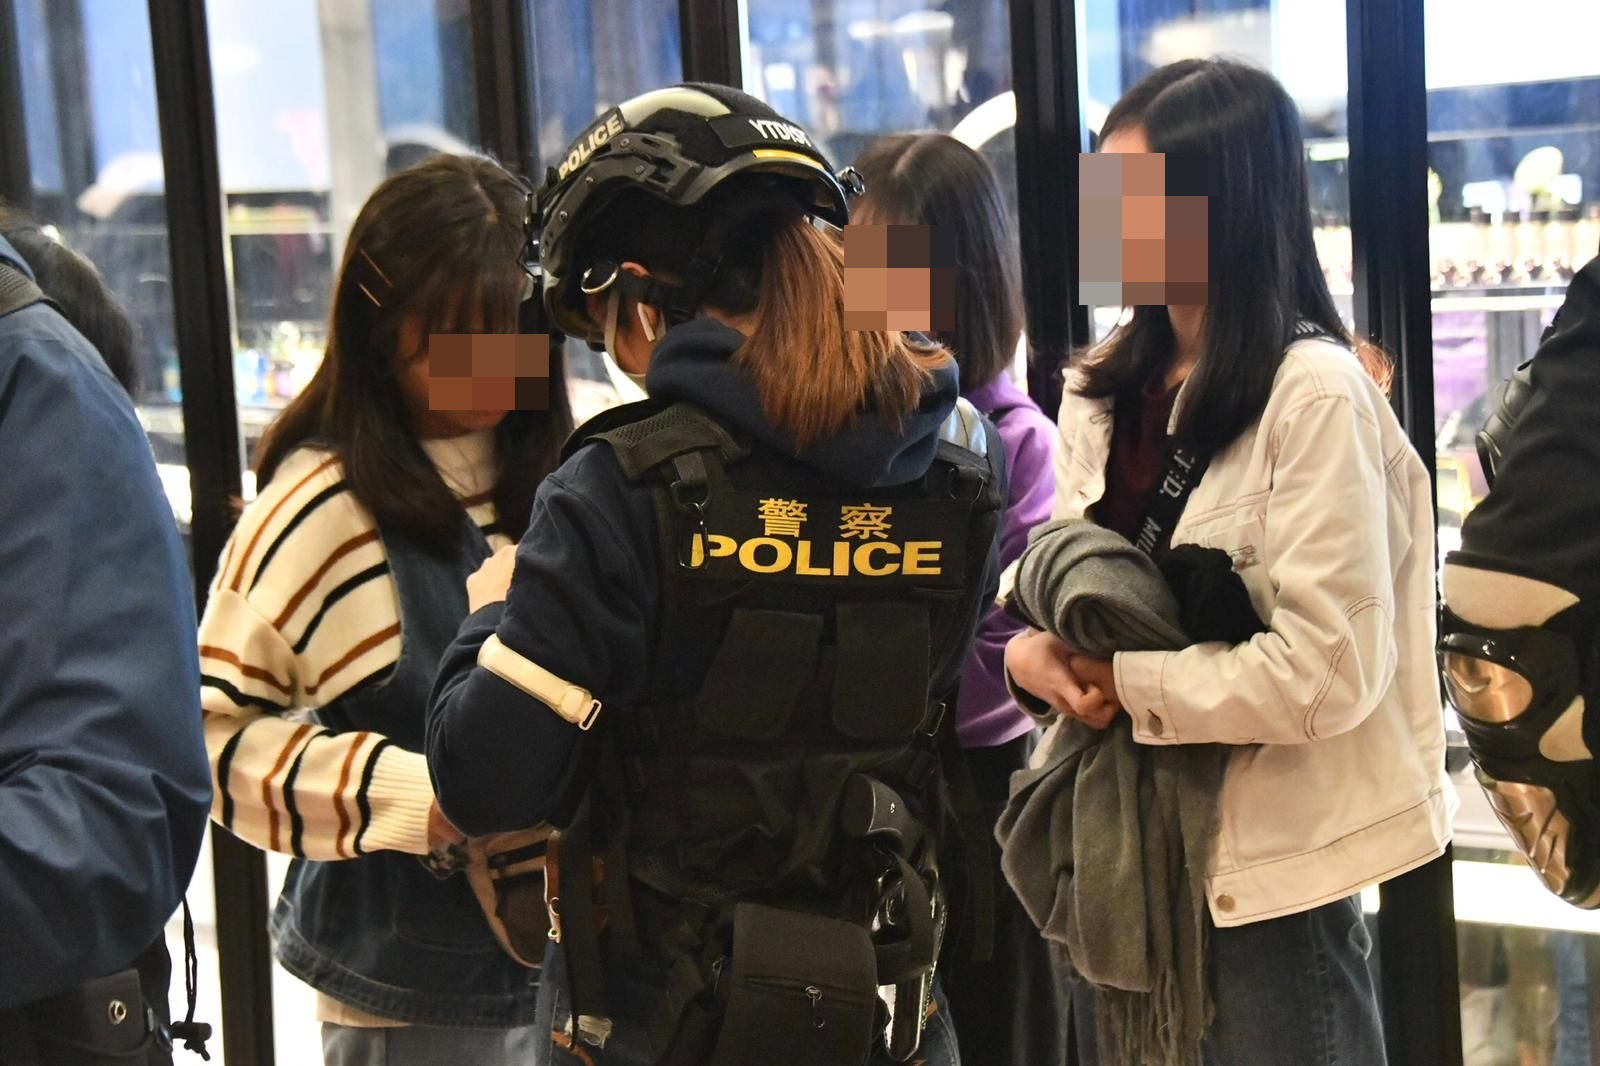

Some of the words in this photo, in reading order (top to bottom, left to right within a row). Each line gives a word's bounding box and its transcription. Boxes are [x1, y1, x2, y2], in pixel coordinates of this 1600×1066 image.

[558, 113, 622, 181] POLICE
[758, 497, 893, 540] 警察
[690, 532, 943, 577] POLICE
